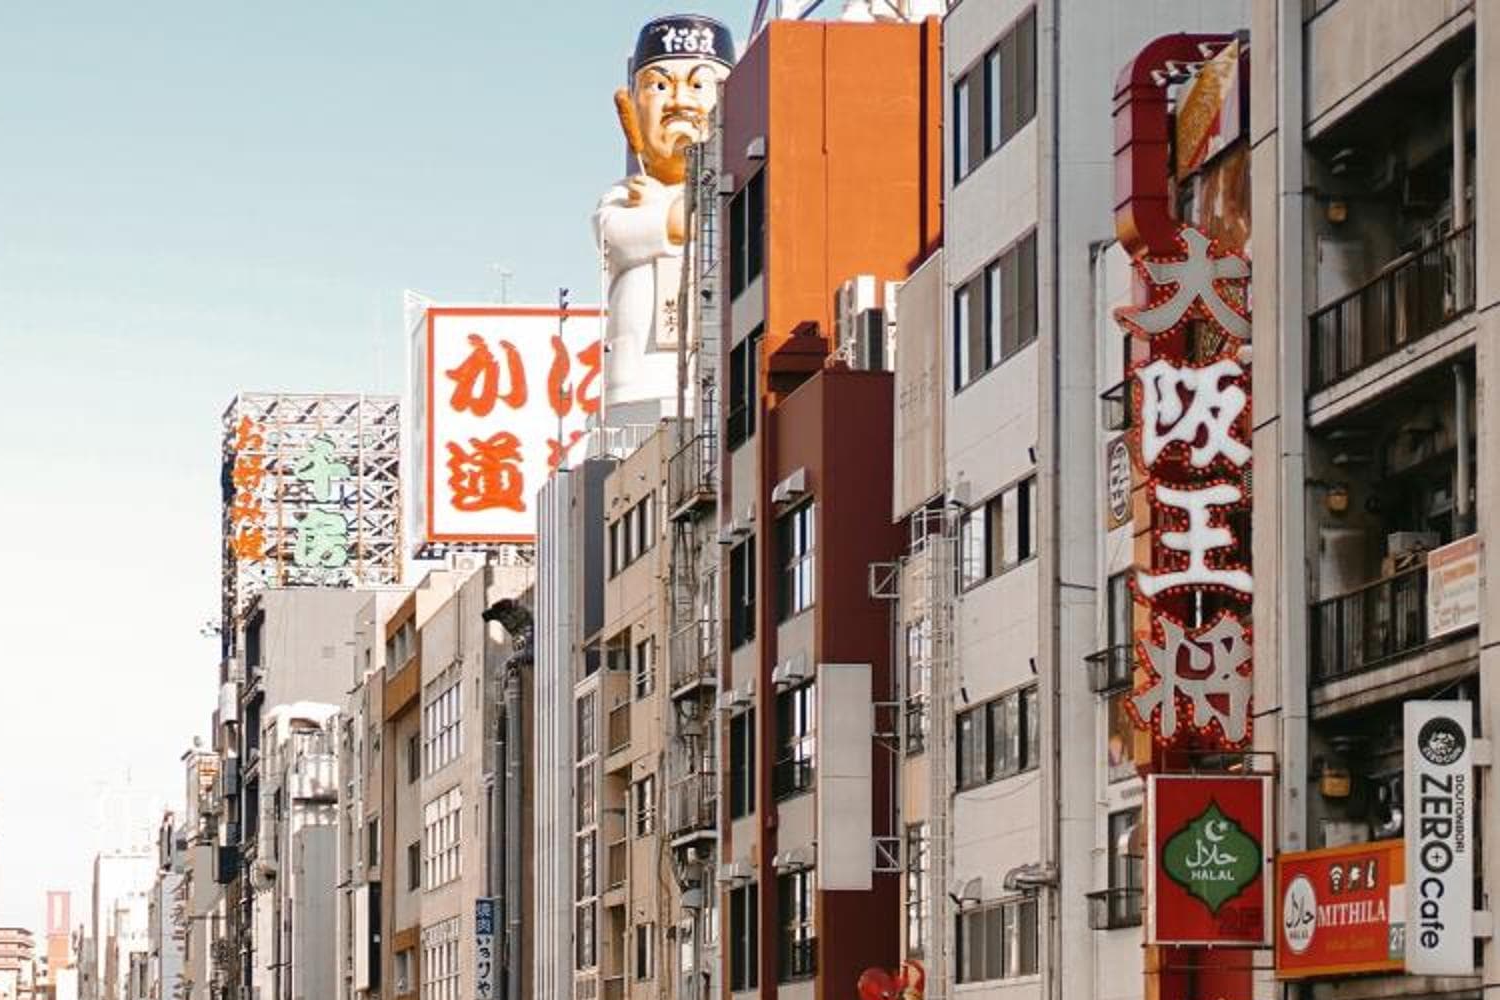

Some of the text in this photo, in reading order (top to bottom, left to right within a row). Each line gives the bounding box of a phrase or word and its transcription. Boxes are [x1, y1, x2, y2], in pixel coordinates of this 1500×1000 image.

[1114, 227, 1252, 743] 大阪王将
[1420, 773, 1453, 873] ZERO
[1191, 869, 1235, 881] HALAL
[1317, 898, 1387, 928] MITHILA
[1420, 877, 1445, 948] Cafe
